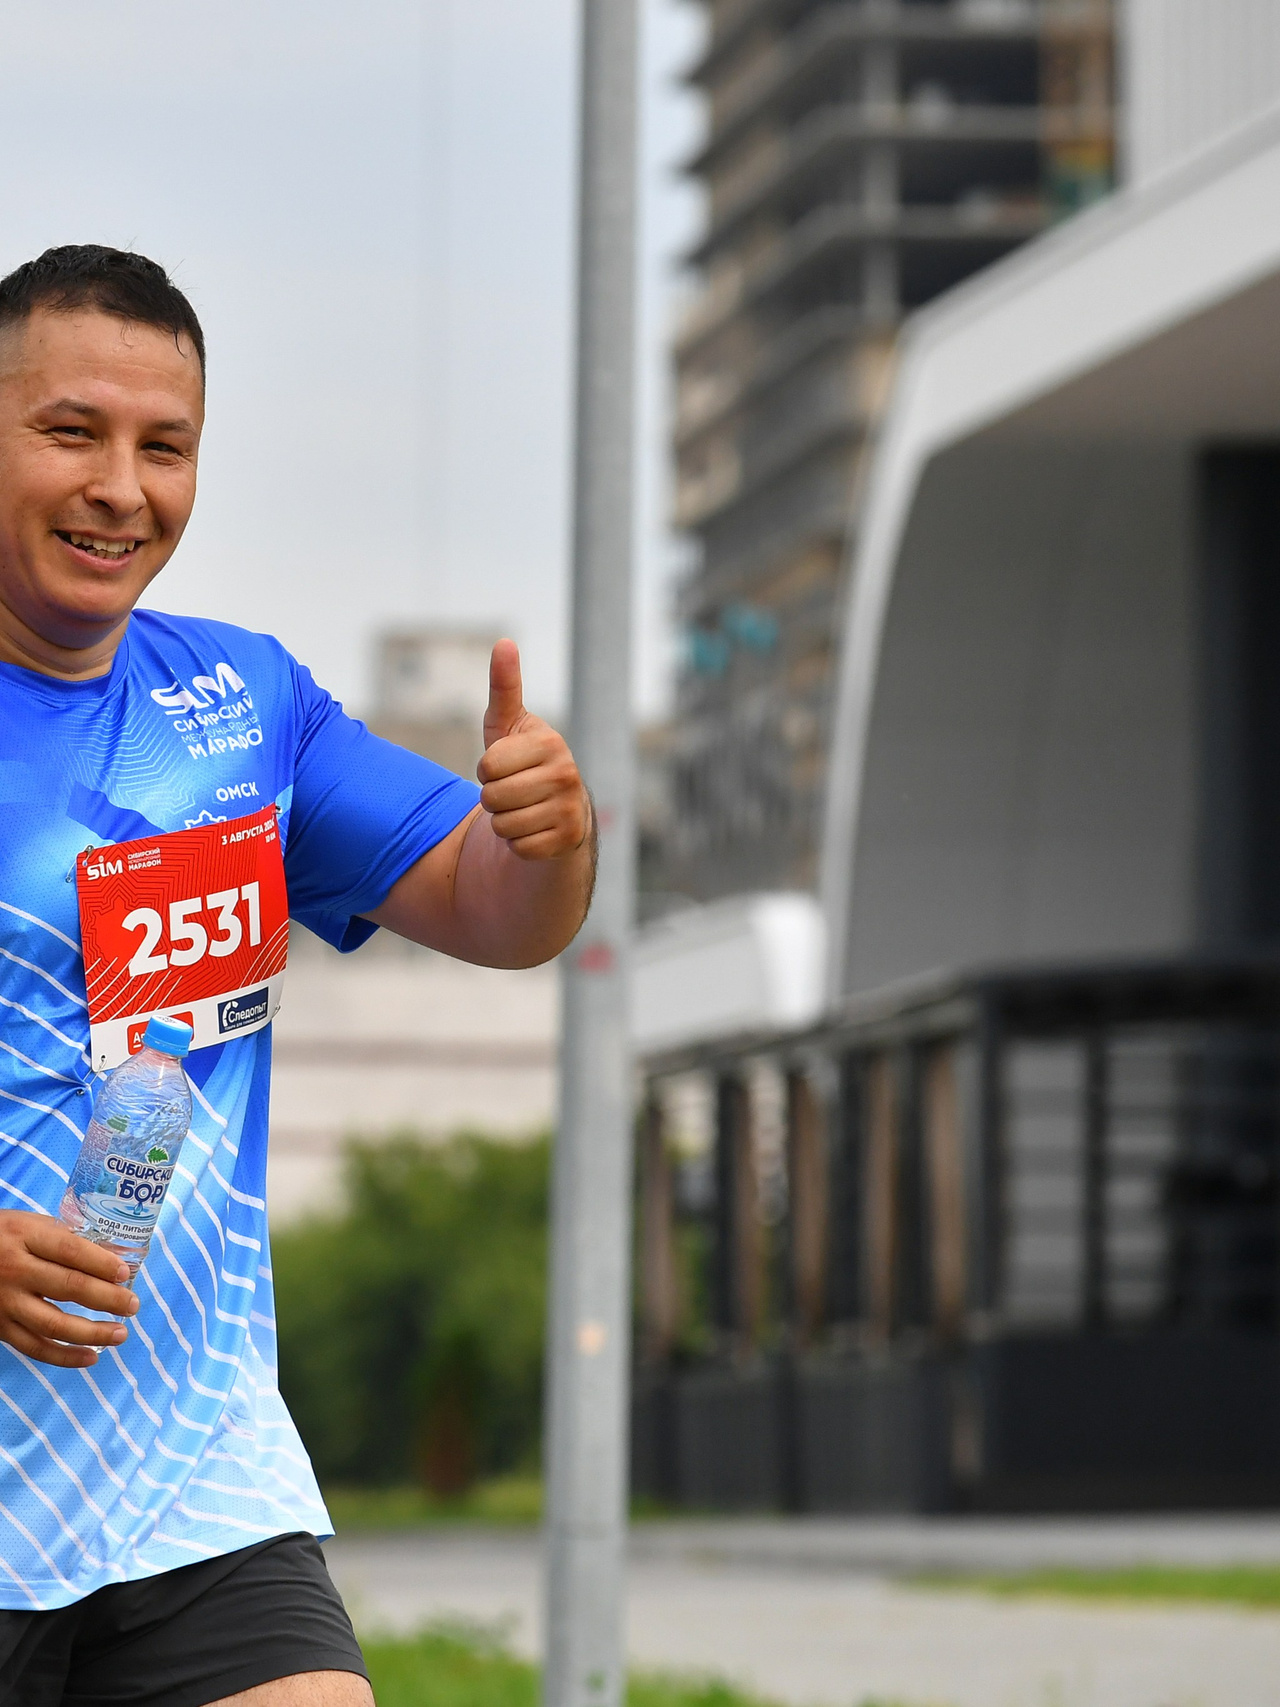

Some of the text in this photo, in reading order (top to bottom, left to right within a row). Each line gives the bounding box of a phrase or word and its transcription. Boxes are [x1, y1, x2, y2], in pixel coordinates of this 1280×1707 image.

[187, 724, 263, 760] МАРАФО
[216, 782, 260, 802] ОМСК
[221, 835, 228, 846] 3
[230, 824, 264, 843] АВГУСТА
[128, 859, 162, 871] МАРАФОН
[121, 881, 261, 977] 2531
[228, 1002, 267, 1023] Следопыт
[107, 1157, 174, 1181] СИБИРСКИ
[119, 1179, 163, 1204] БОР
[98, 1217, 154, 1234] вода питьева
[100, 1227, 150, 1240] негазированна
